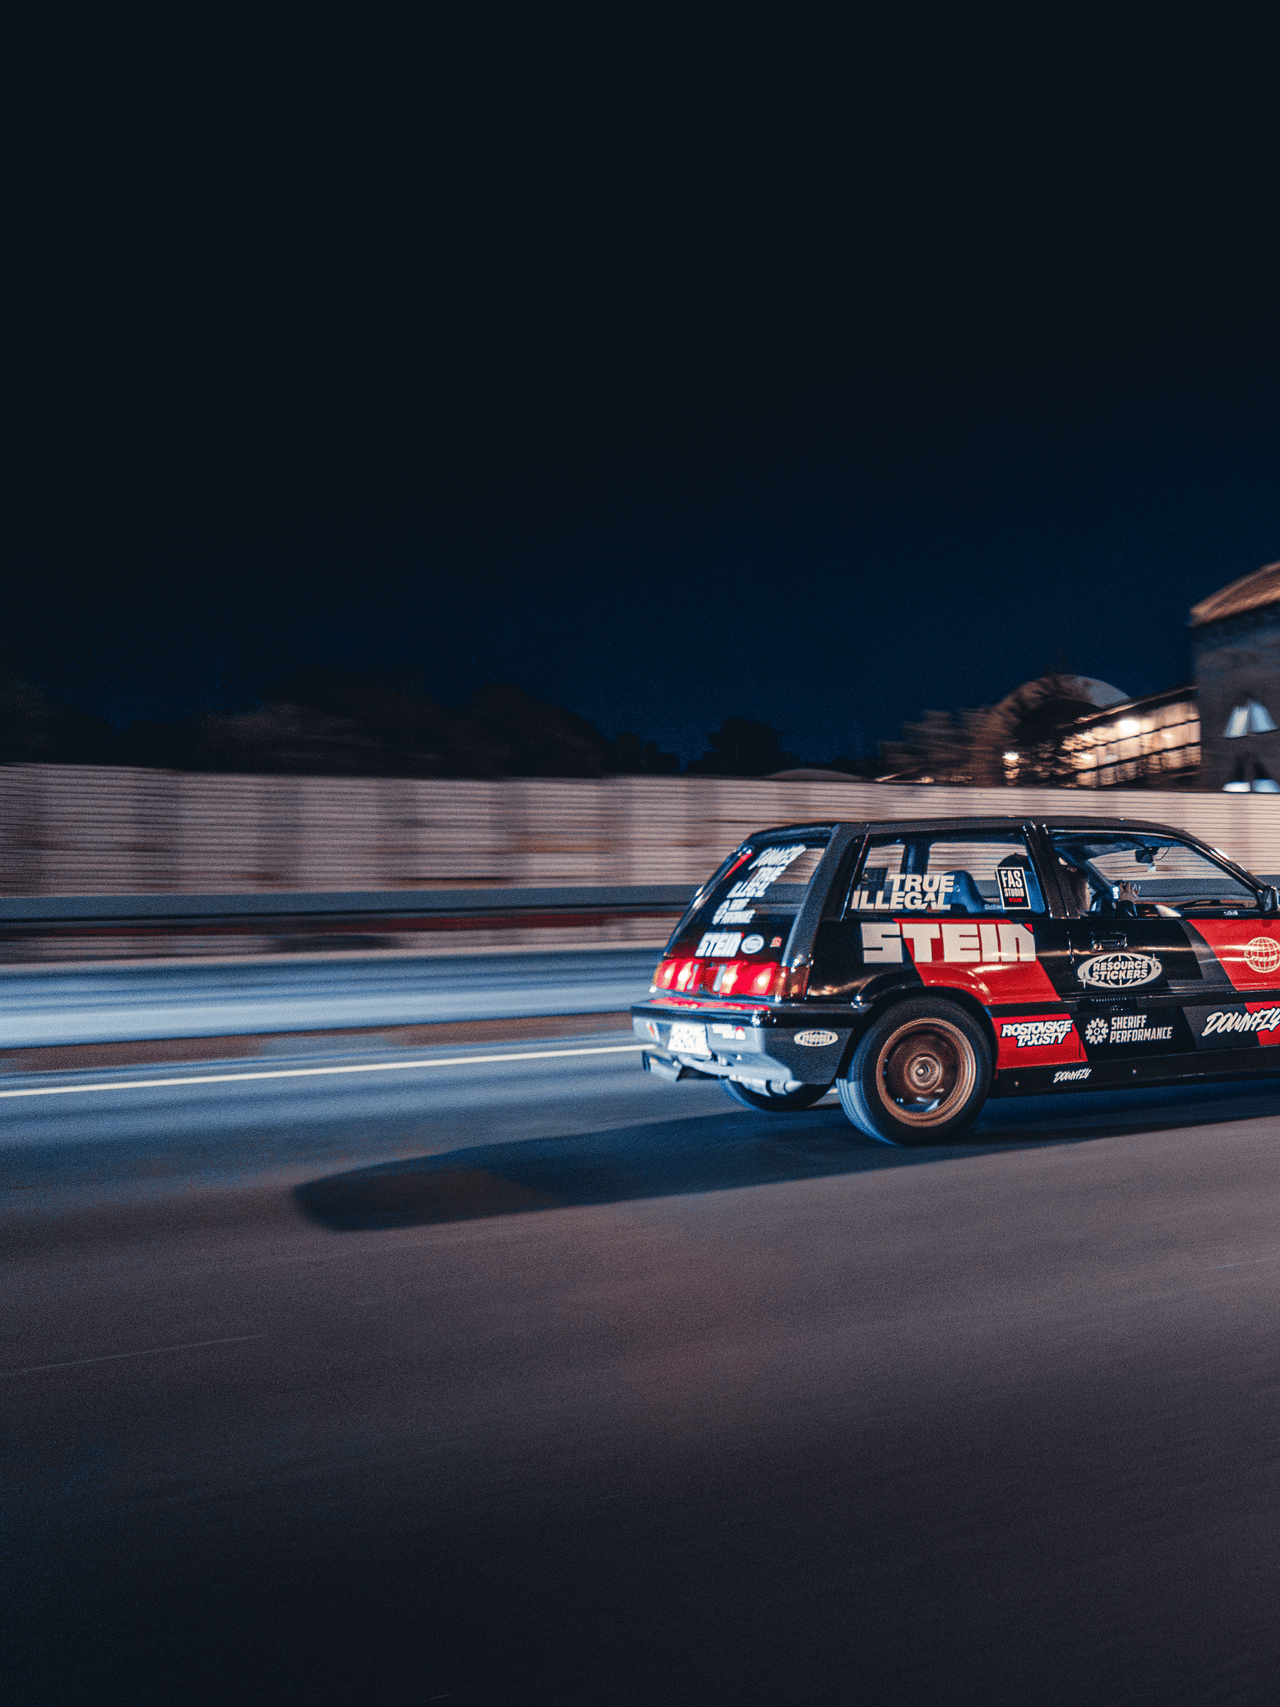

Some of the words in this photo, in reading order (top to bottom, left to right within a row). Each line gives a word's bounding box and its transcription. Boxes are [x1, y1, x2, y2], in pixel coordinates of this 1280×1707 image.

[889, 874, 955, 893] TRUE
[1000, 870, 1023, 888] FAS
[850, 890, 952, 910] ILLEGAL
[1003, 887, 1025, 898] STUDIO
[860, 922, 1037, 964] STEIN
[1092, 960, 1148, 972] RESOURCE
[1092, 969, 1148, 981] STICKERS
[1110, 1014, 1147, 1030] SHERIFF
[1109, 1026, 1173, 1043] PERFORMANCE
